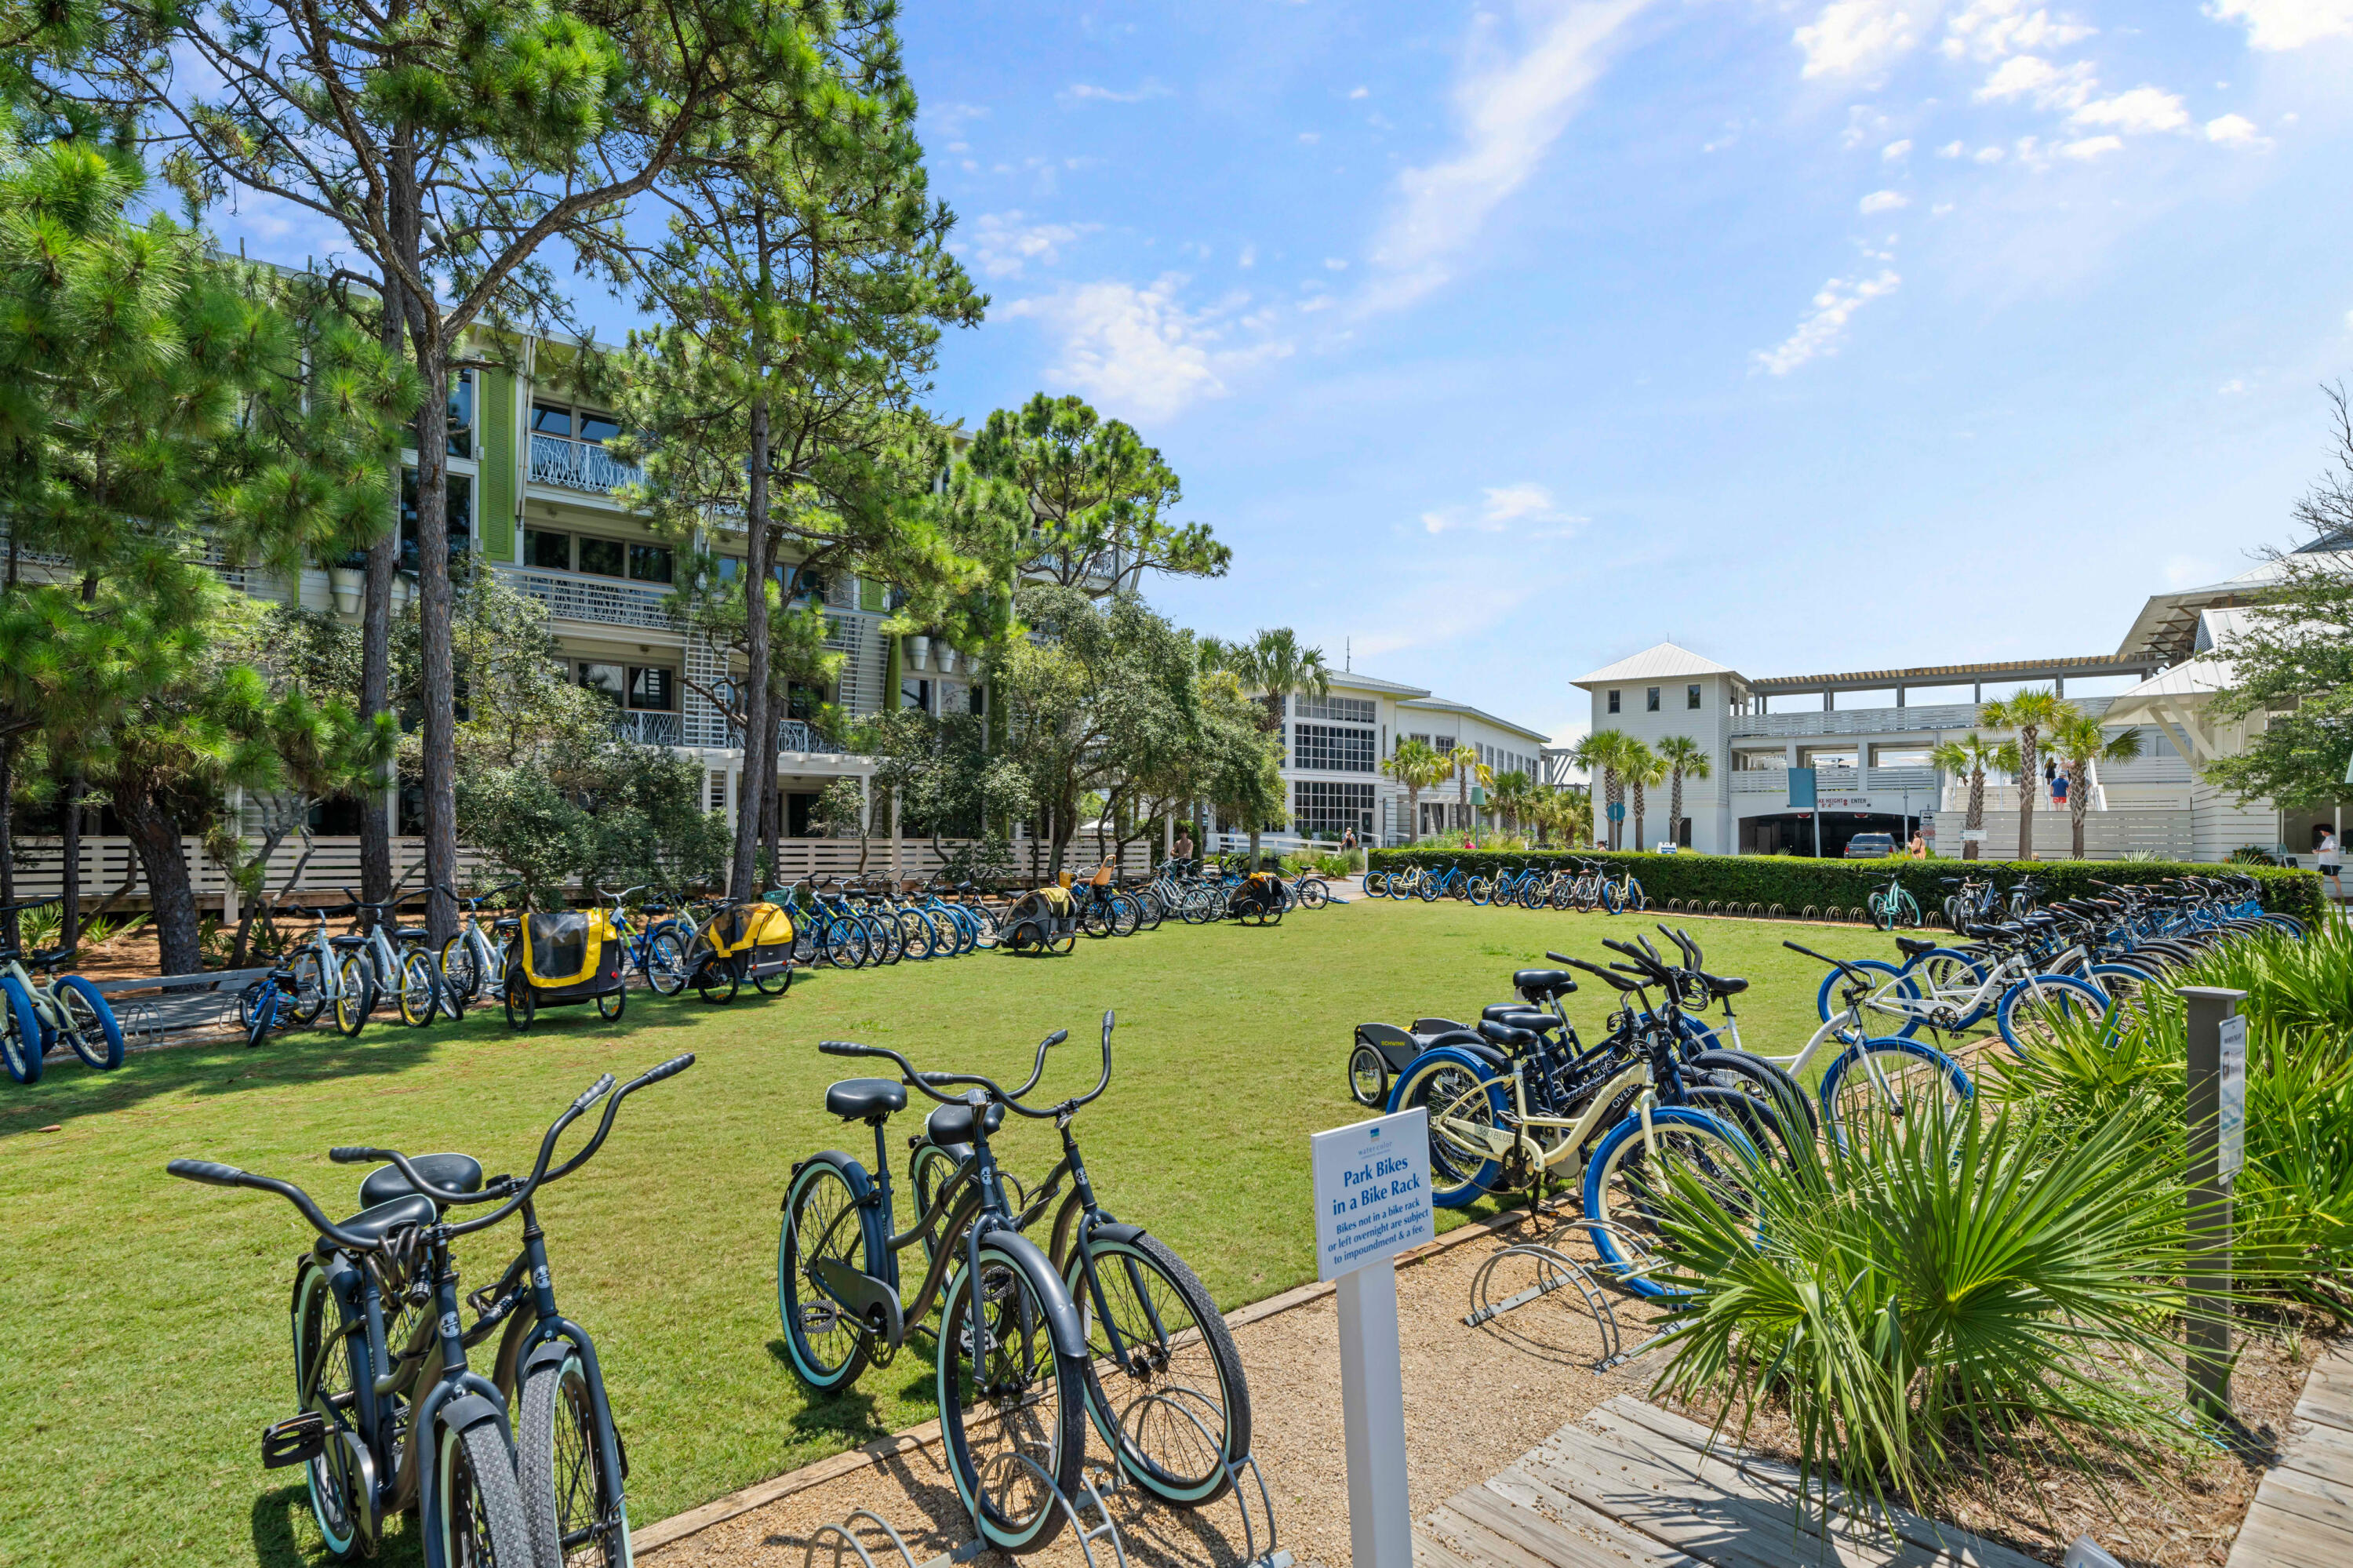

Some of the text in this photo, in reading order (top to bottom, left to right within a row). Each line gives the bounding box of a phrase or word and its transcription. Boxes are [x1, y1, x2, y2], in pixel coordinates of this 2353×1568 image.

[1478, 1126, 1514, 1144] 360 BLUE
[1344, 1157, 1409, 1188] Park Bikes
[1333, 1173, 1420, 1216] in a Bike Rack
[1328, 1209, 1428, 1253] or left overnight are subject
[1336, 1221, 1357, 1235] Bikes
[1358, 1215, 1371, 1227] not
[1373, 1212, 1380, 1222] in
[1387, 1204, 1403, 1217] bike
[1405, 1197, 1420, 1210] rack
[1334, 1255, 1342, 1264] to
[1344, 1234, 1397, 1261] impoundment
[1398, 1231, 1405, 1240] &
[1412, 1224, 1425, 1235] fee.
